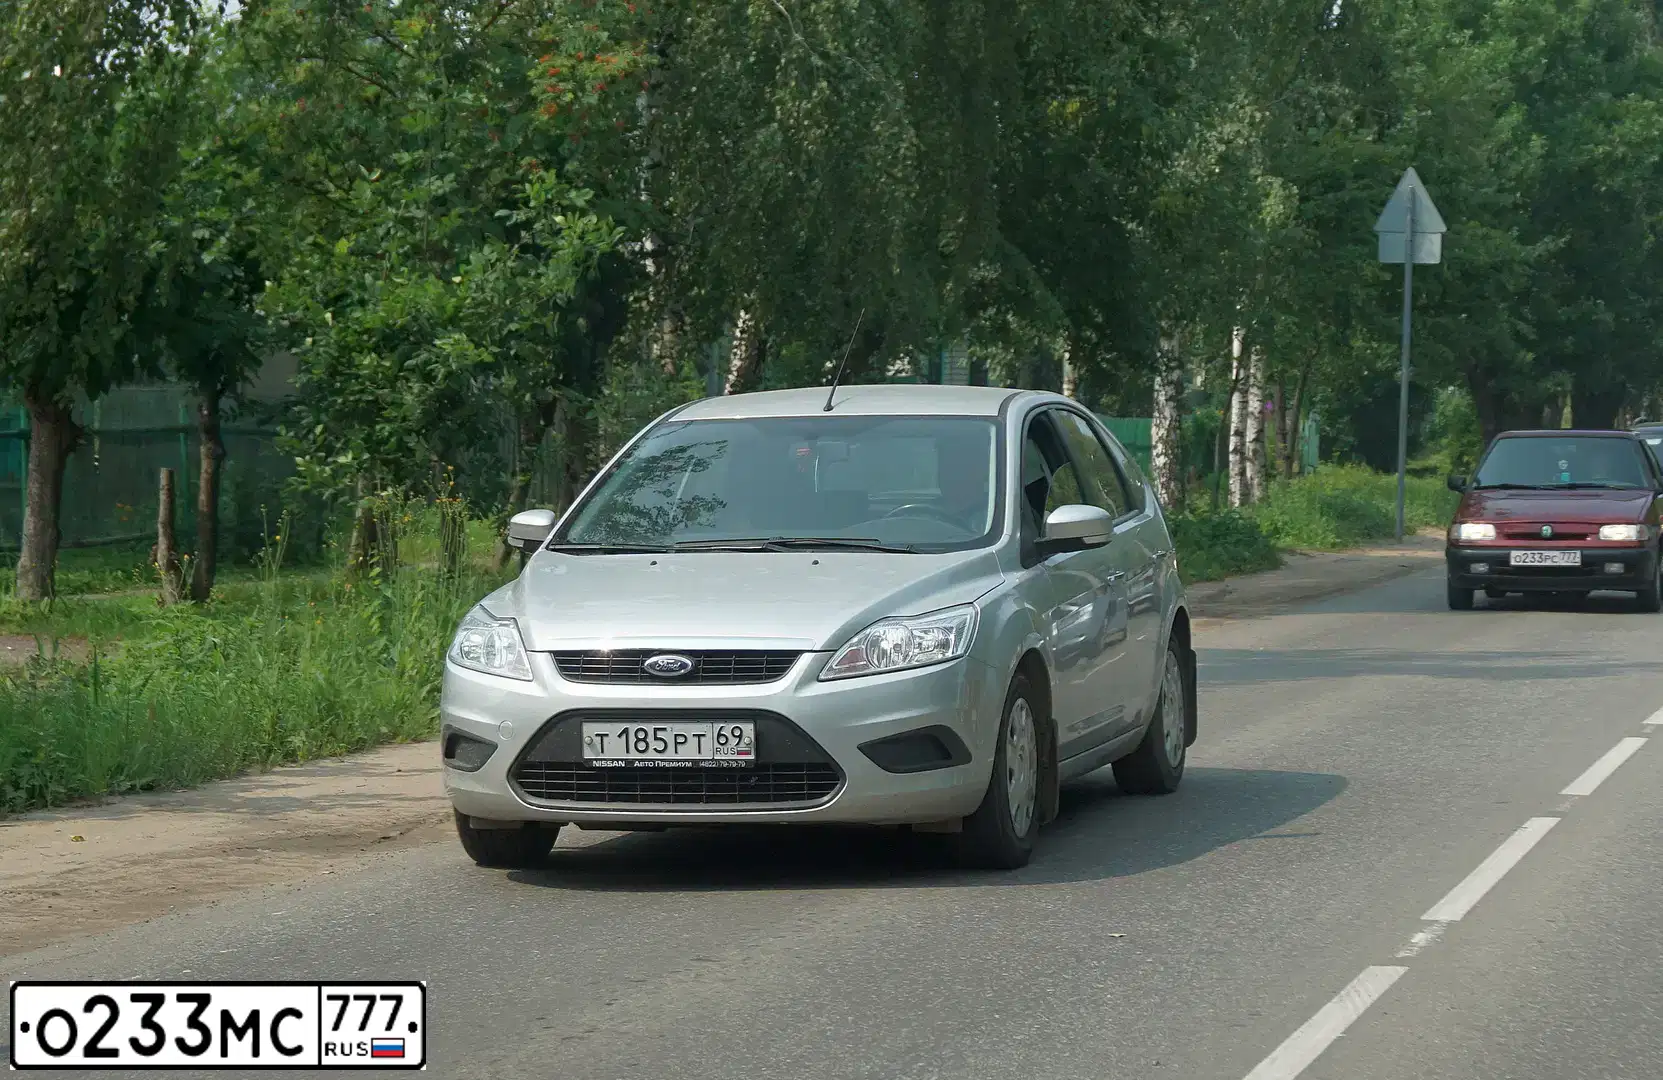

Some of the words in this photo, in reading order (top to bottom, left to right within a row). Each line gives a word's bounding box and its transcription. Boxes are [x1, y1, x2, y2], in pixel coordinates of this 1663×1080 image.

[655, 660, 681, 670] Ford
[716, 725, 744, 747] 69
[715, 747, 736, 756] RUS
[592, 760, 626, 768] NISSAN
